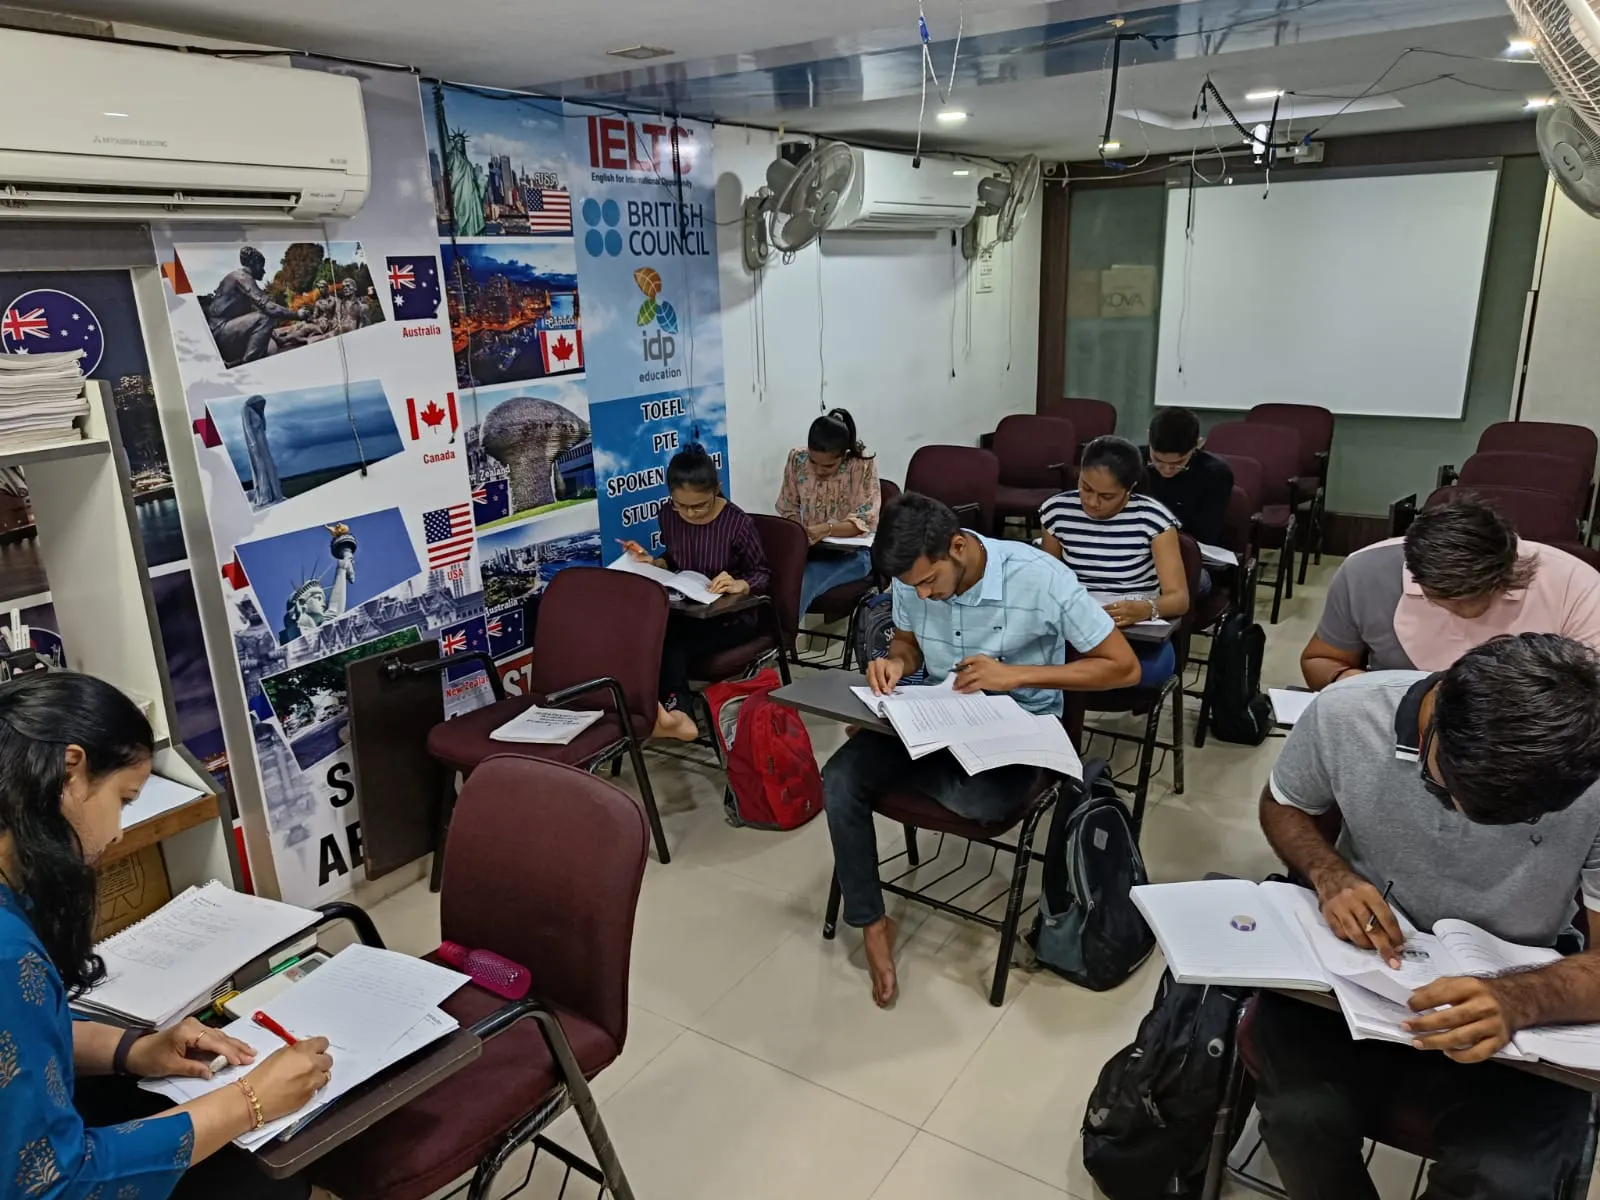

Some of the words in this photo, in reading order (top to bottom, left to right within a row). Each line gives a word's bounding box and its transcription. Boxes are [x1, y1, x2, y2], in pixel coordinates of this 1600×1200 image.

[591, 172, 615, 184] English
[616, 175, 624, 184] for
[628, 201, 703, 228] BRITISH
[629, 230, 710, 256] COUNCIL
[402, 325, 441, 338] Australia
[642, 329, 676, 367] idp
[639, 368, 682, 383] education
[641, 398, 685, 423] TOEFL
[653, 431, 679, 453] PTE
[423, 450, 456, 465] Canada
[607, 466, 665, 497] SPOKEN
[447, 568, 464, 581] USA
[463, 675, 489, 692] Zeala
